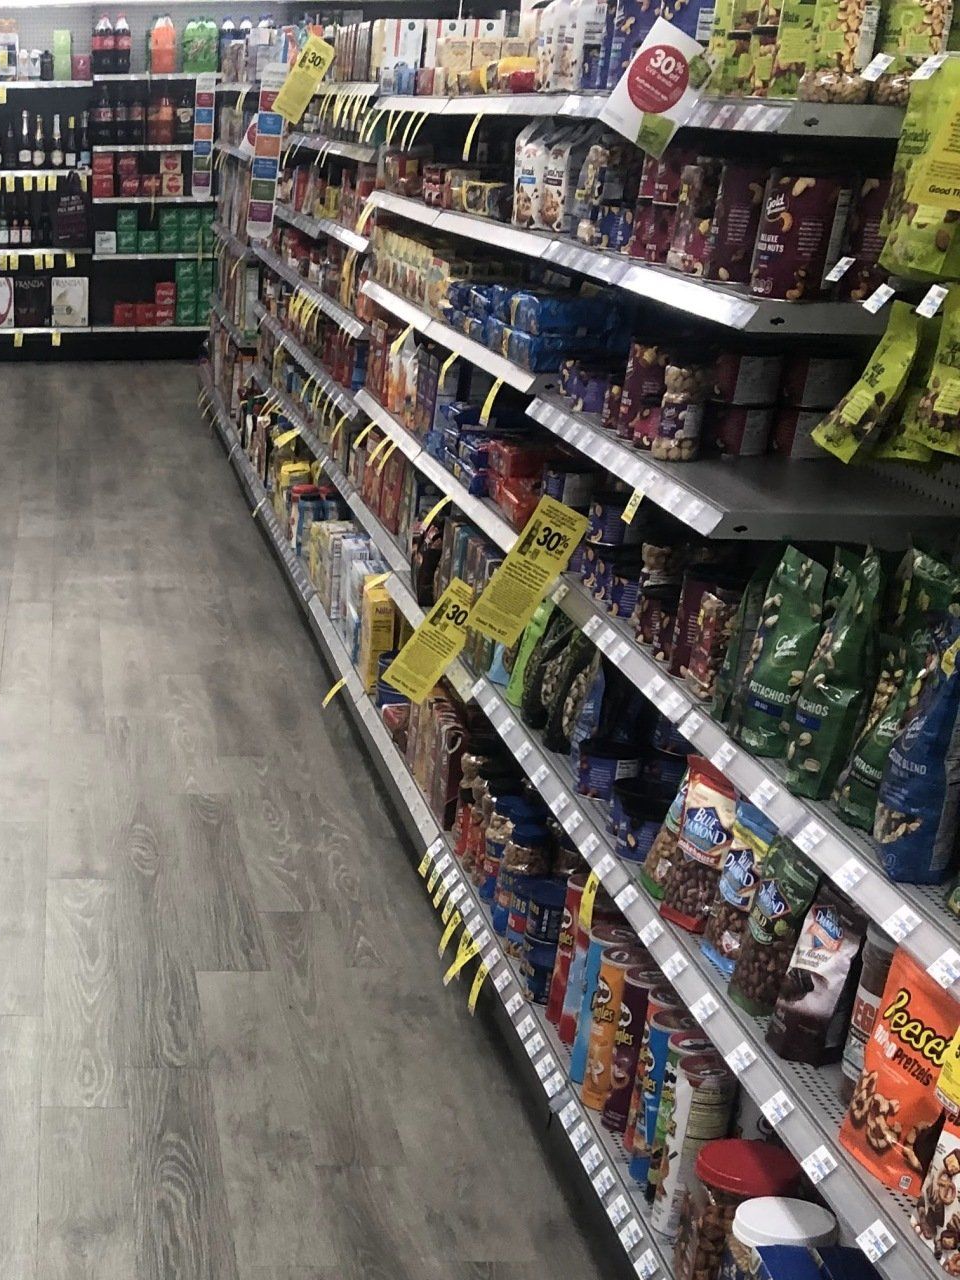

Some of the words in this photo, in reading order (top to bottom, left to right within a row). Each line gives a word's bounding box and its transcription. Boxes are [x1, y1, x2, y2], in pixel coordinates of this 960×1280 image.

[650, 49, 685, 75] 30%
[766, 193, 785, 210] Gold
[928, 184, 951, 196] Good
[15, 280, 45, 289] FRANZIA
[536, 526, 571, 552] 30%
[749, 680, 791, 705] PISTACHIOS
[902, 759, 927, 775] BLEND
[693, 807, 720, 831] BLUE
[737, 849, 755, 873] BLUE
[815, 910, 843, 939] DIAMOND
[895, 1047, 934, 1087] Pretzels
